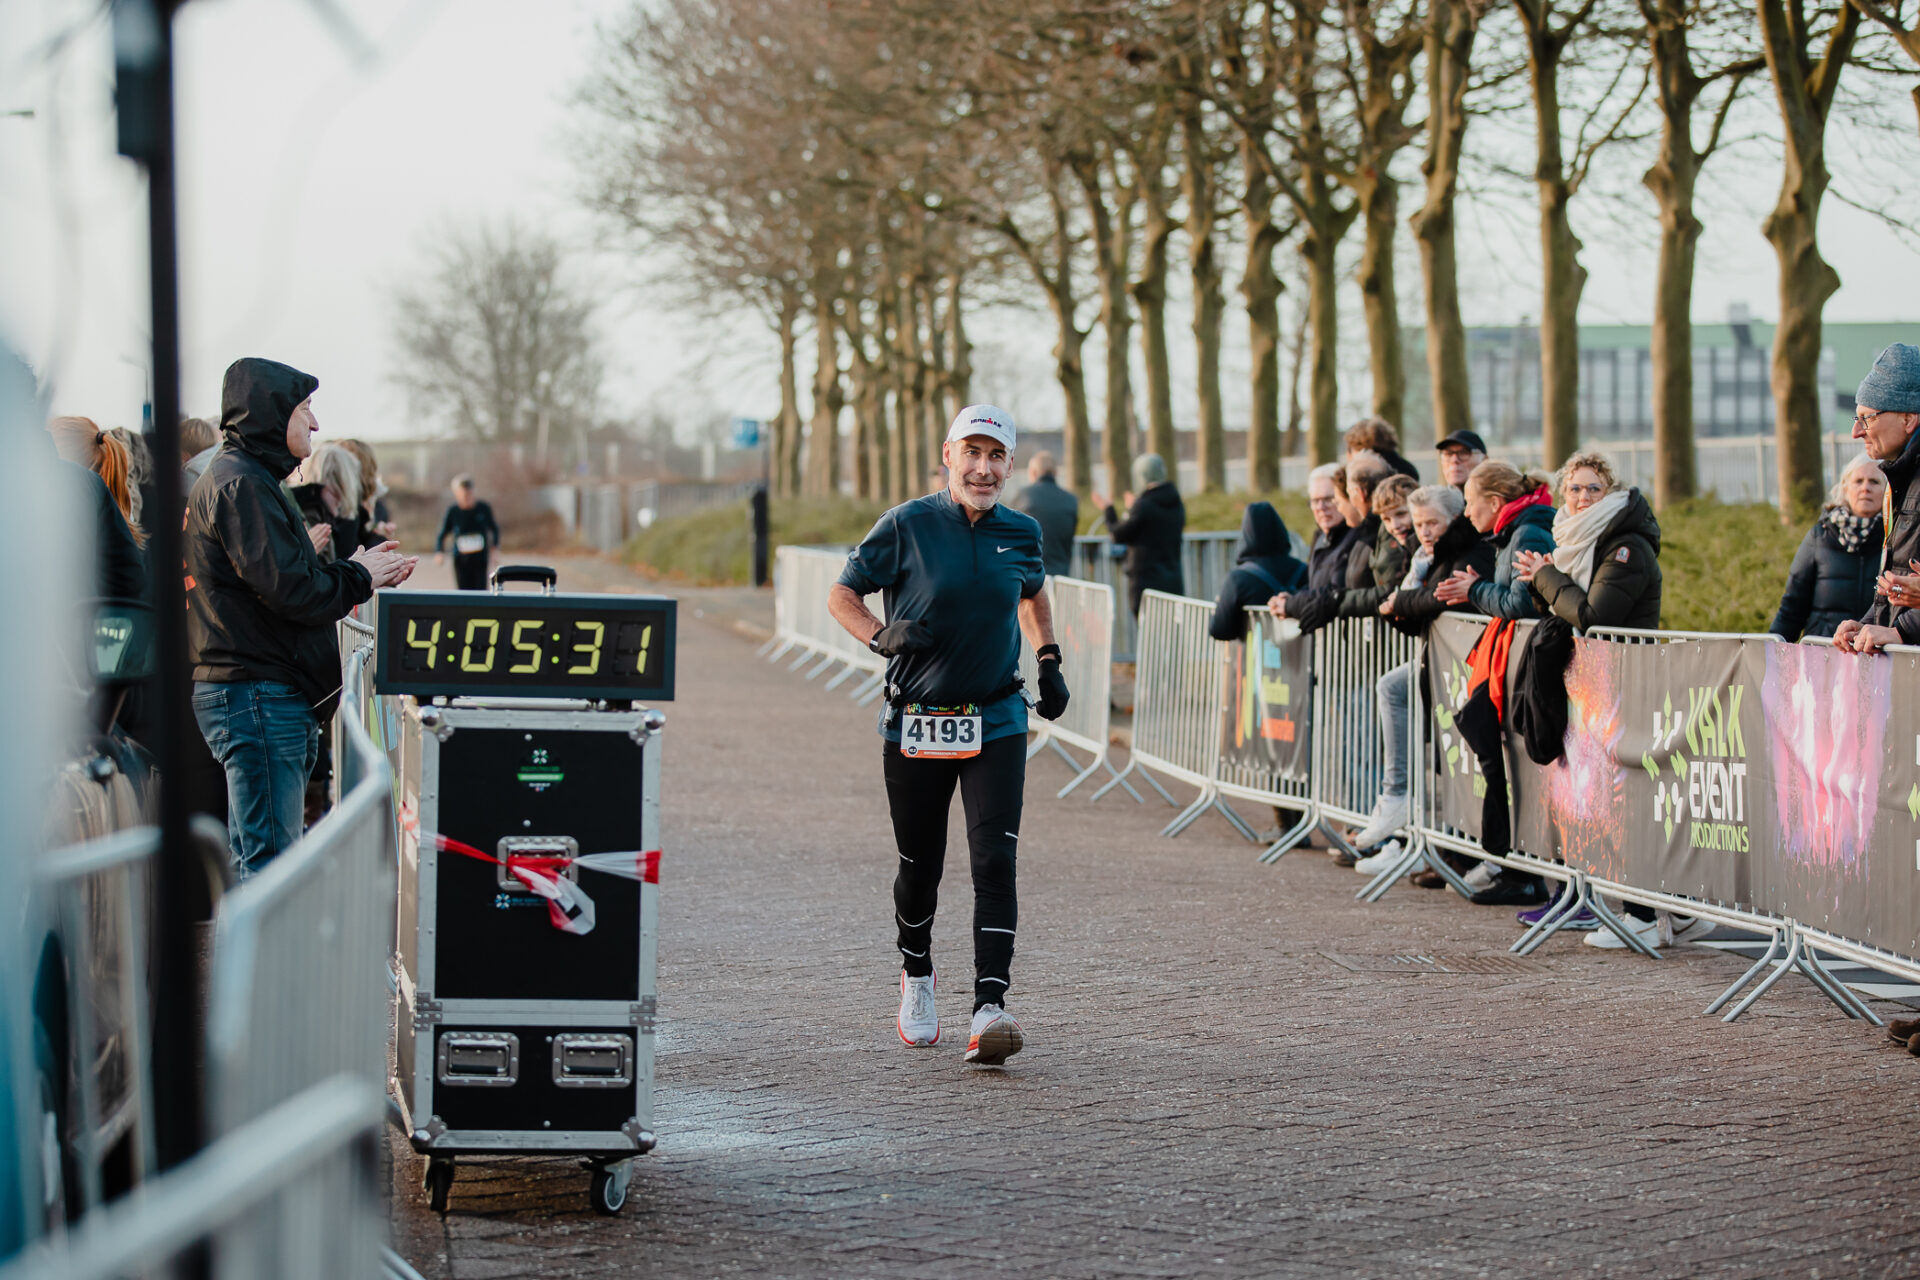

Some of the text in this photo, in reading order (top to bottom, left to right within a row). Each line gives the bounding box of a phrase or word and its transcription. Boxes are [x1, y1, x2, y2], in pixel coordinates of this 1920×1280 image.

[406, 618, 651, 675] 4:05:31
[907, 718, 975, 743] 4193
[1685, 685, 1746, 757] VALK
[1689, 761, 1746, 821] EVENT
